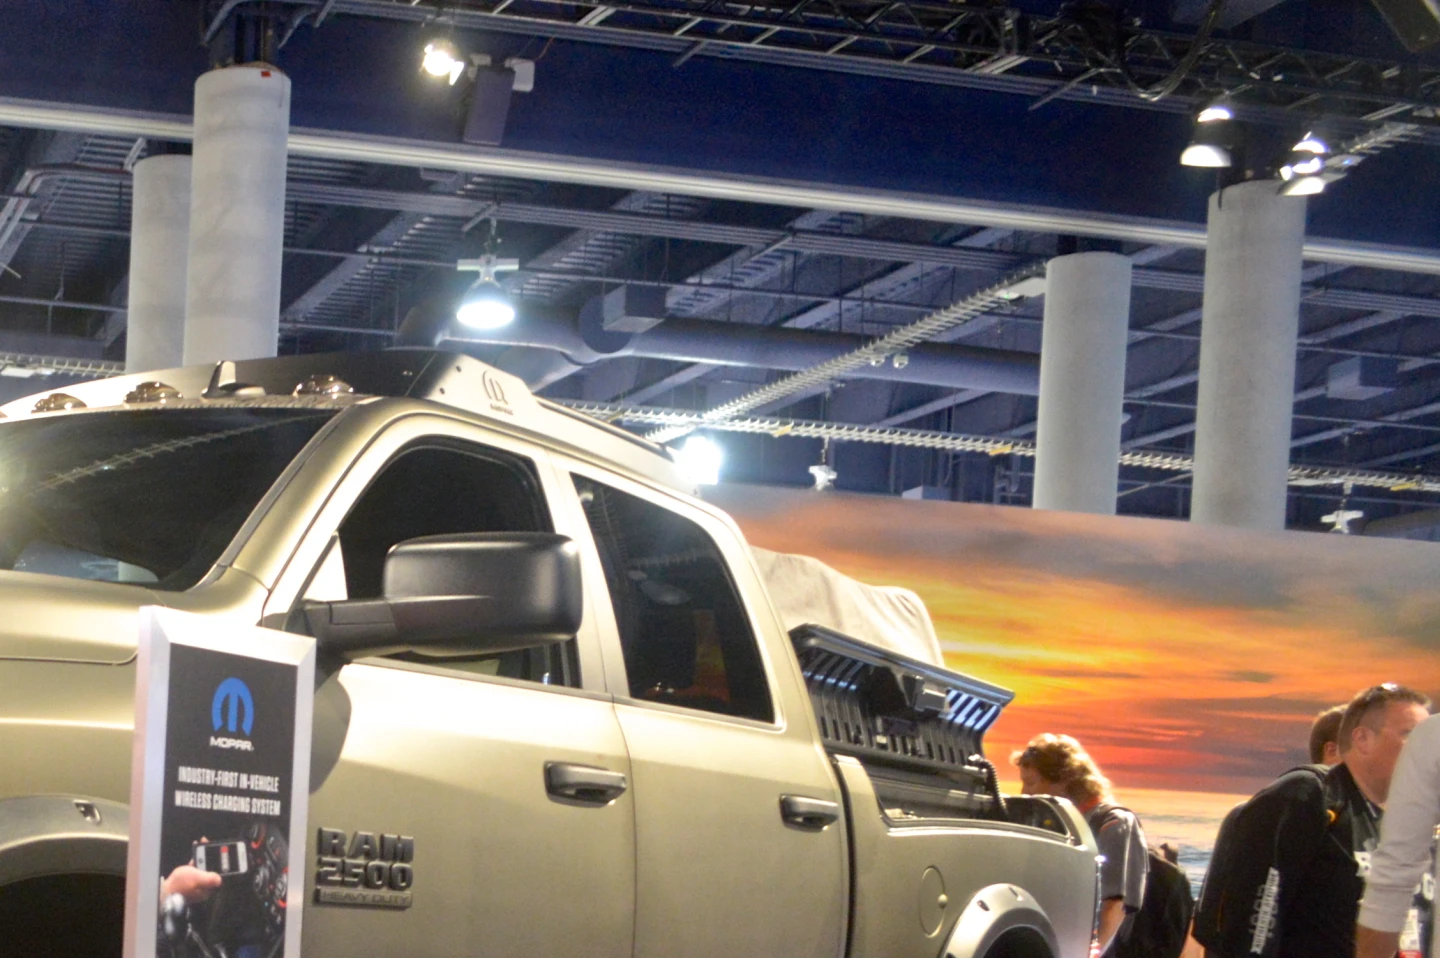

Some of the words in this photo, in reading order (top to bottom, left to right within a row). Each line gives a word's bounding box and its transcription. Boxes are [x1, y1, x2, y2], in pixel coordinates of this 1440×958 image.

[209, 736, 252, 751] MOPAR
[178, 765, 239, 788] INDUSTRY-FIRST
[239, 773, 279, 793] IN-VEHICLE
[174, 789, 212, 809] WIRELESS
[212, 793, 251, 813] CHARGING
[251, 797, 281, 816] SYSTEM
[317, 827, 414, 863] RAM
[315, 857, 414, 892] 2500
